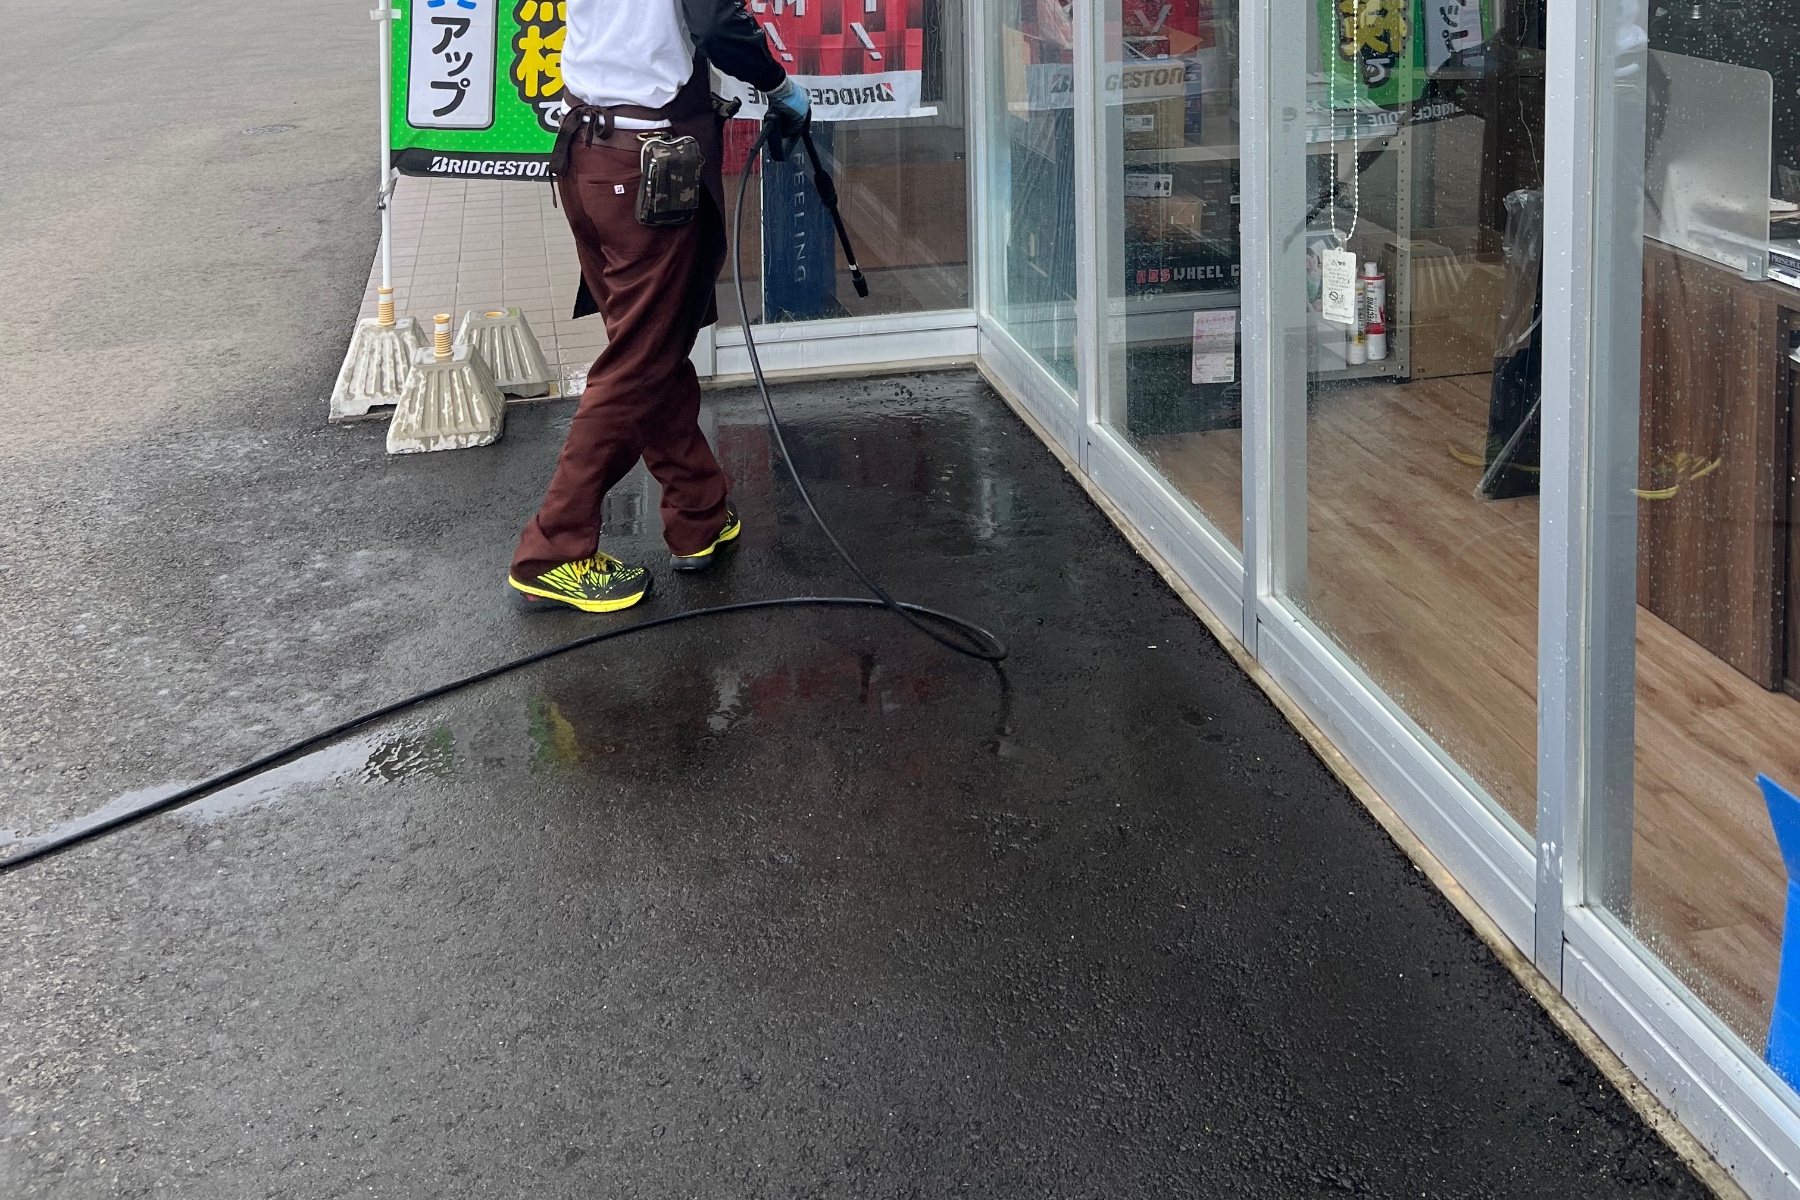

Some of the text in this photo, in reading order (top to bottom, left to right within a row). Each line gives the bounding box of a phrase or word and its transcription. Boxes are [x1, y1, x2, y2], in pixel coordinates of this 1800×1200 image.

[429, 156, 557, 177] BRIDGESTON
[793, 152, 806, 283] FEELING
[1173, 265, 1224, 280] WHEEL
